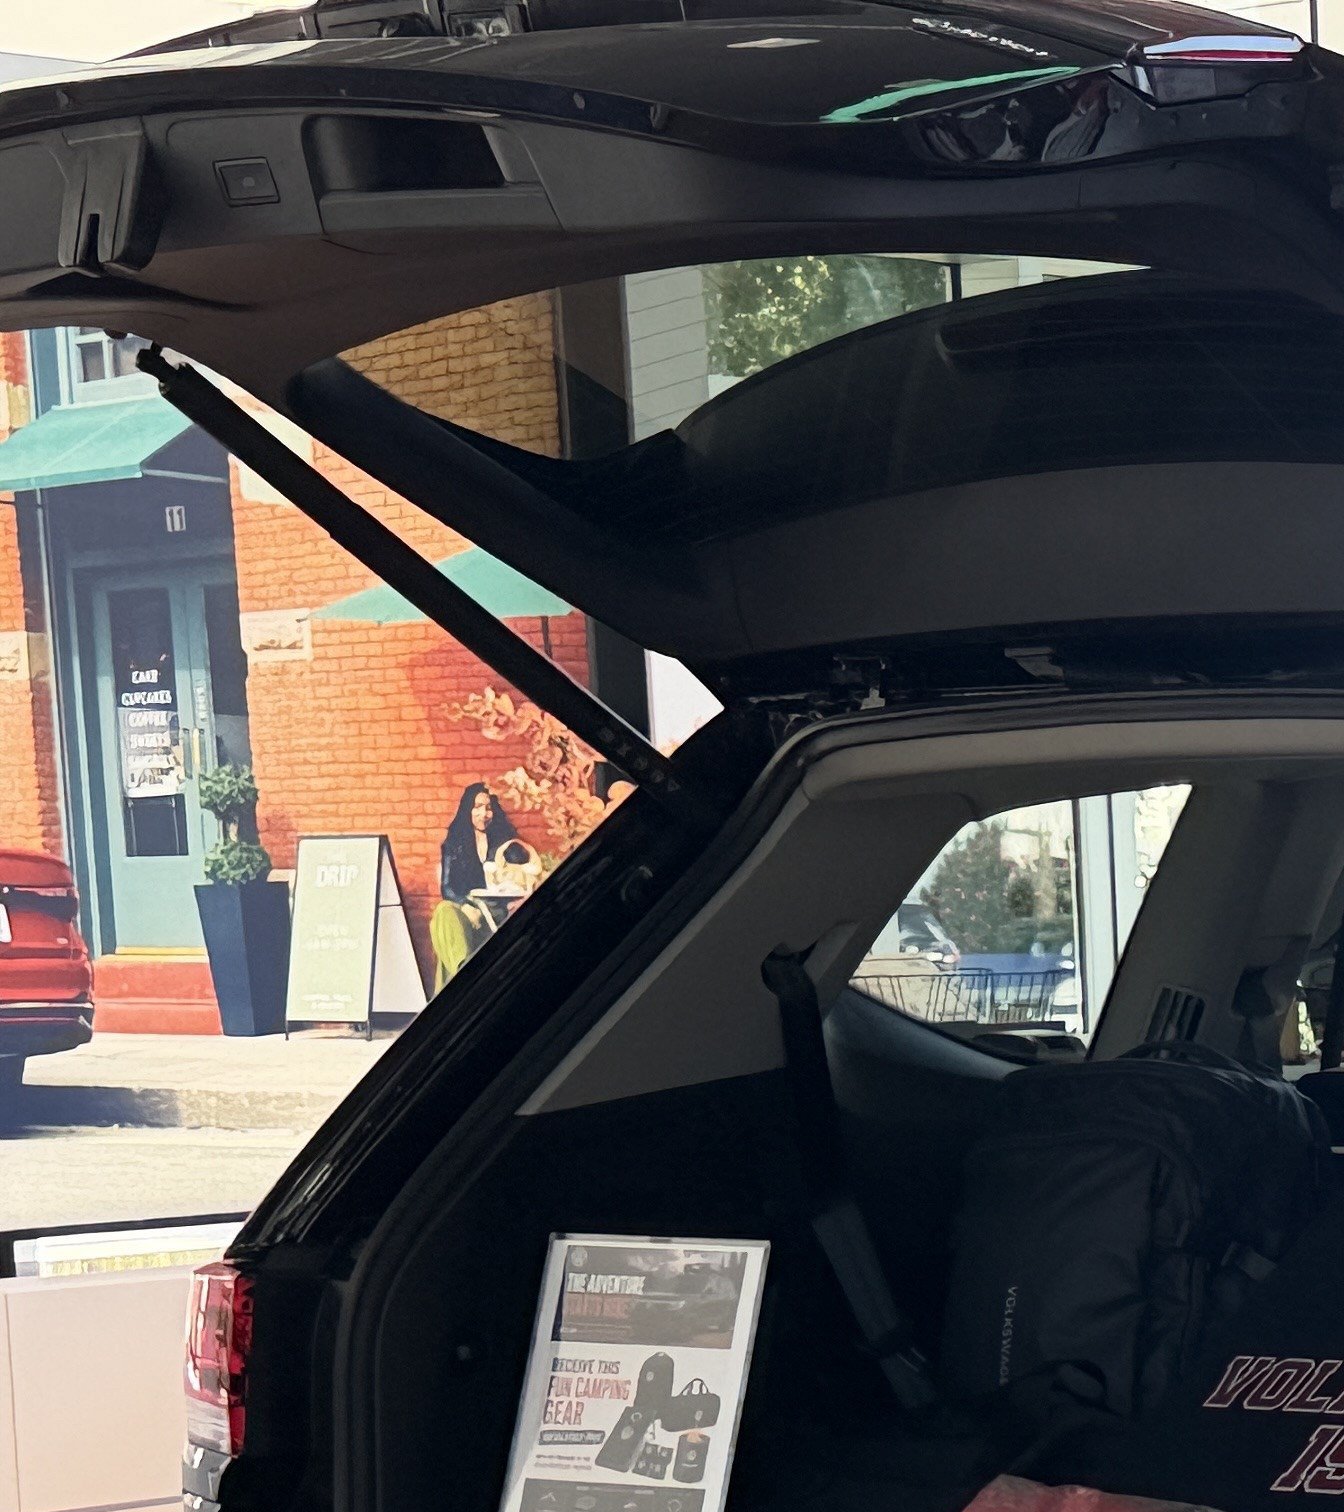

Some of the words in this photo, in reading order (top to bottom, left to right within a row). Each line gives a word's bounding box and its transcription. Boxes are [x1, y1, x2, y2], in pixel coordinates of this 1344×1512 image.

[547, 1375, 573, 1398] FUN
[575, 1376, 632, 1400] CAMPING
[542, 1399, 585, 1426] GEAR
